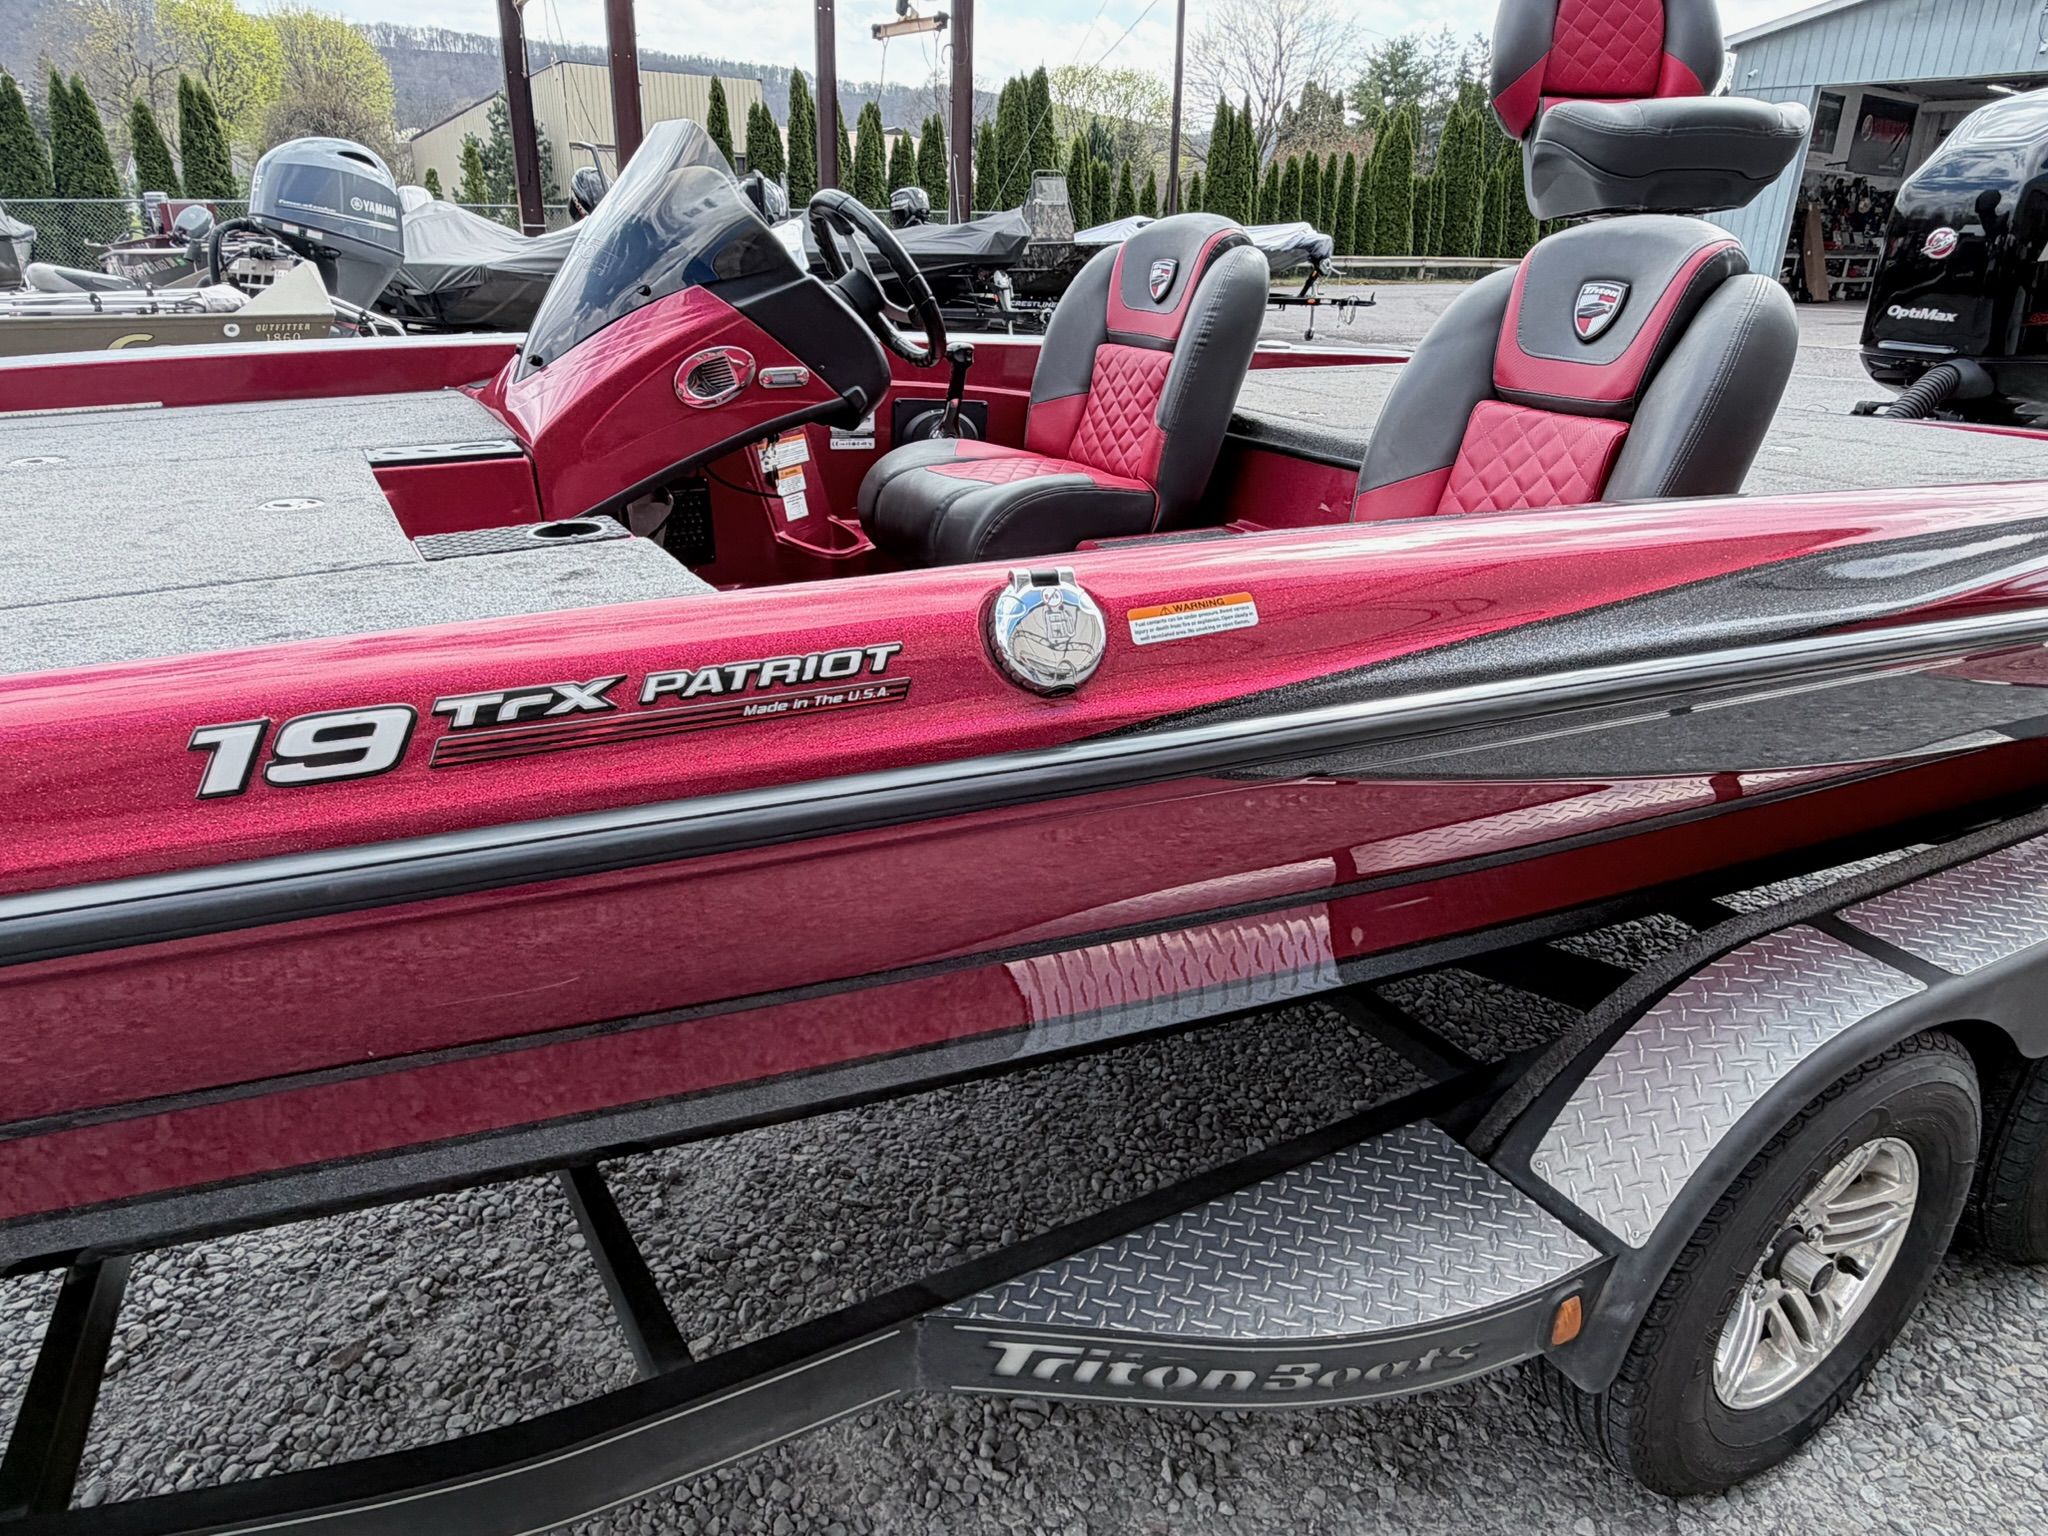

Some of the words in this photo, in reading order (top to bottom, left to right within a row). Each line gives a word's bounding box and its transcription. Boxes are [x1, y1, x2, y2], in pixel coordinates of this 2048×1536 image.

[363, 199, 397, 219] YAMAHA
[1010, 300, 1059, 308] CRESTLINE
[1887, 304, 1959, 322] OptiMax
[255, 323, 311, 332] OUTFITTER
[1173, 598, 1225, 613] WARNING
[743, 702, 788, 717] Made
[814, 694, 844, 707] The
[847, 686, 891, 701] U.S.A.
[188, 702, 418, 799] 19
[639, 641, 902, 704] PATRIOT
[986, 1340, 1257, 1392] Triton
[1262, 1342, 1482, 1392] Boats
